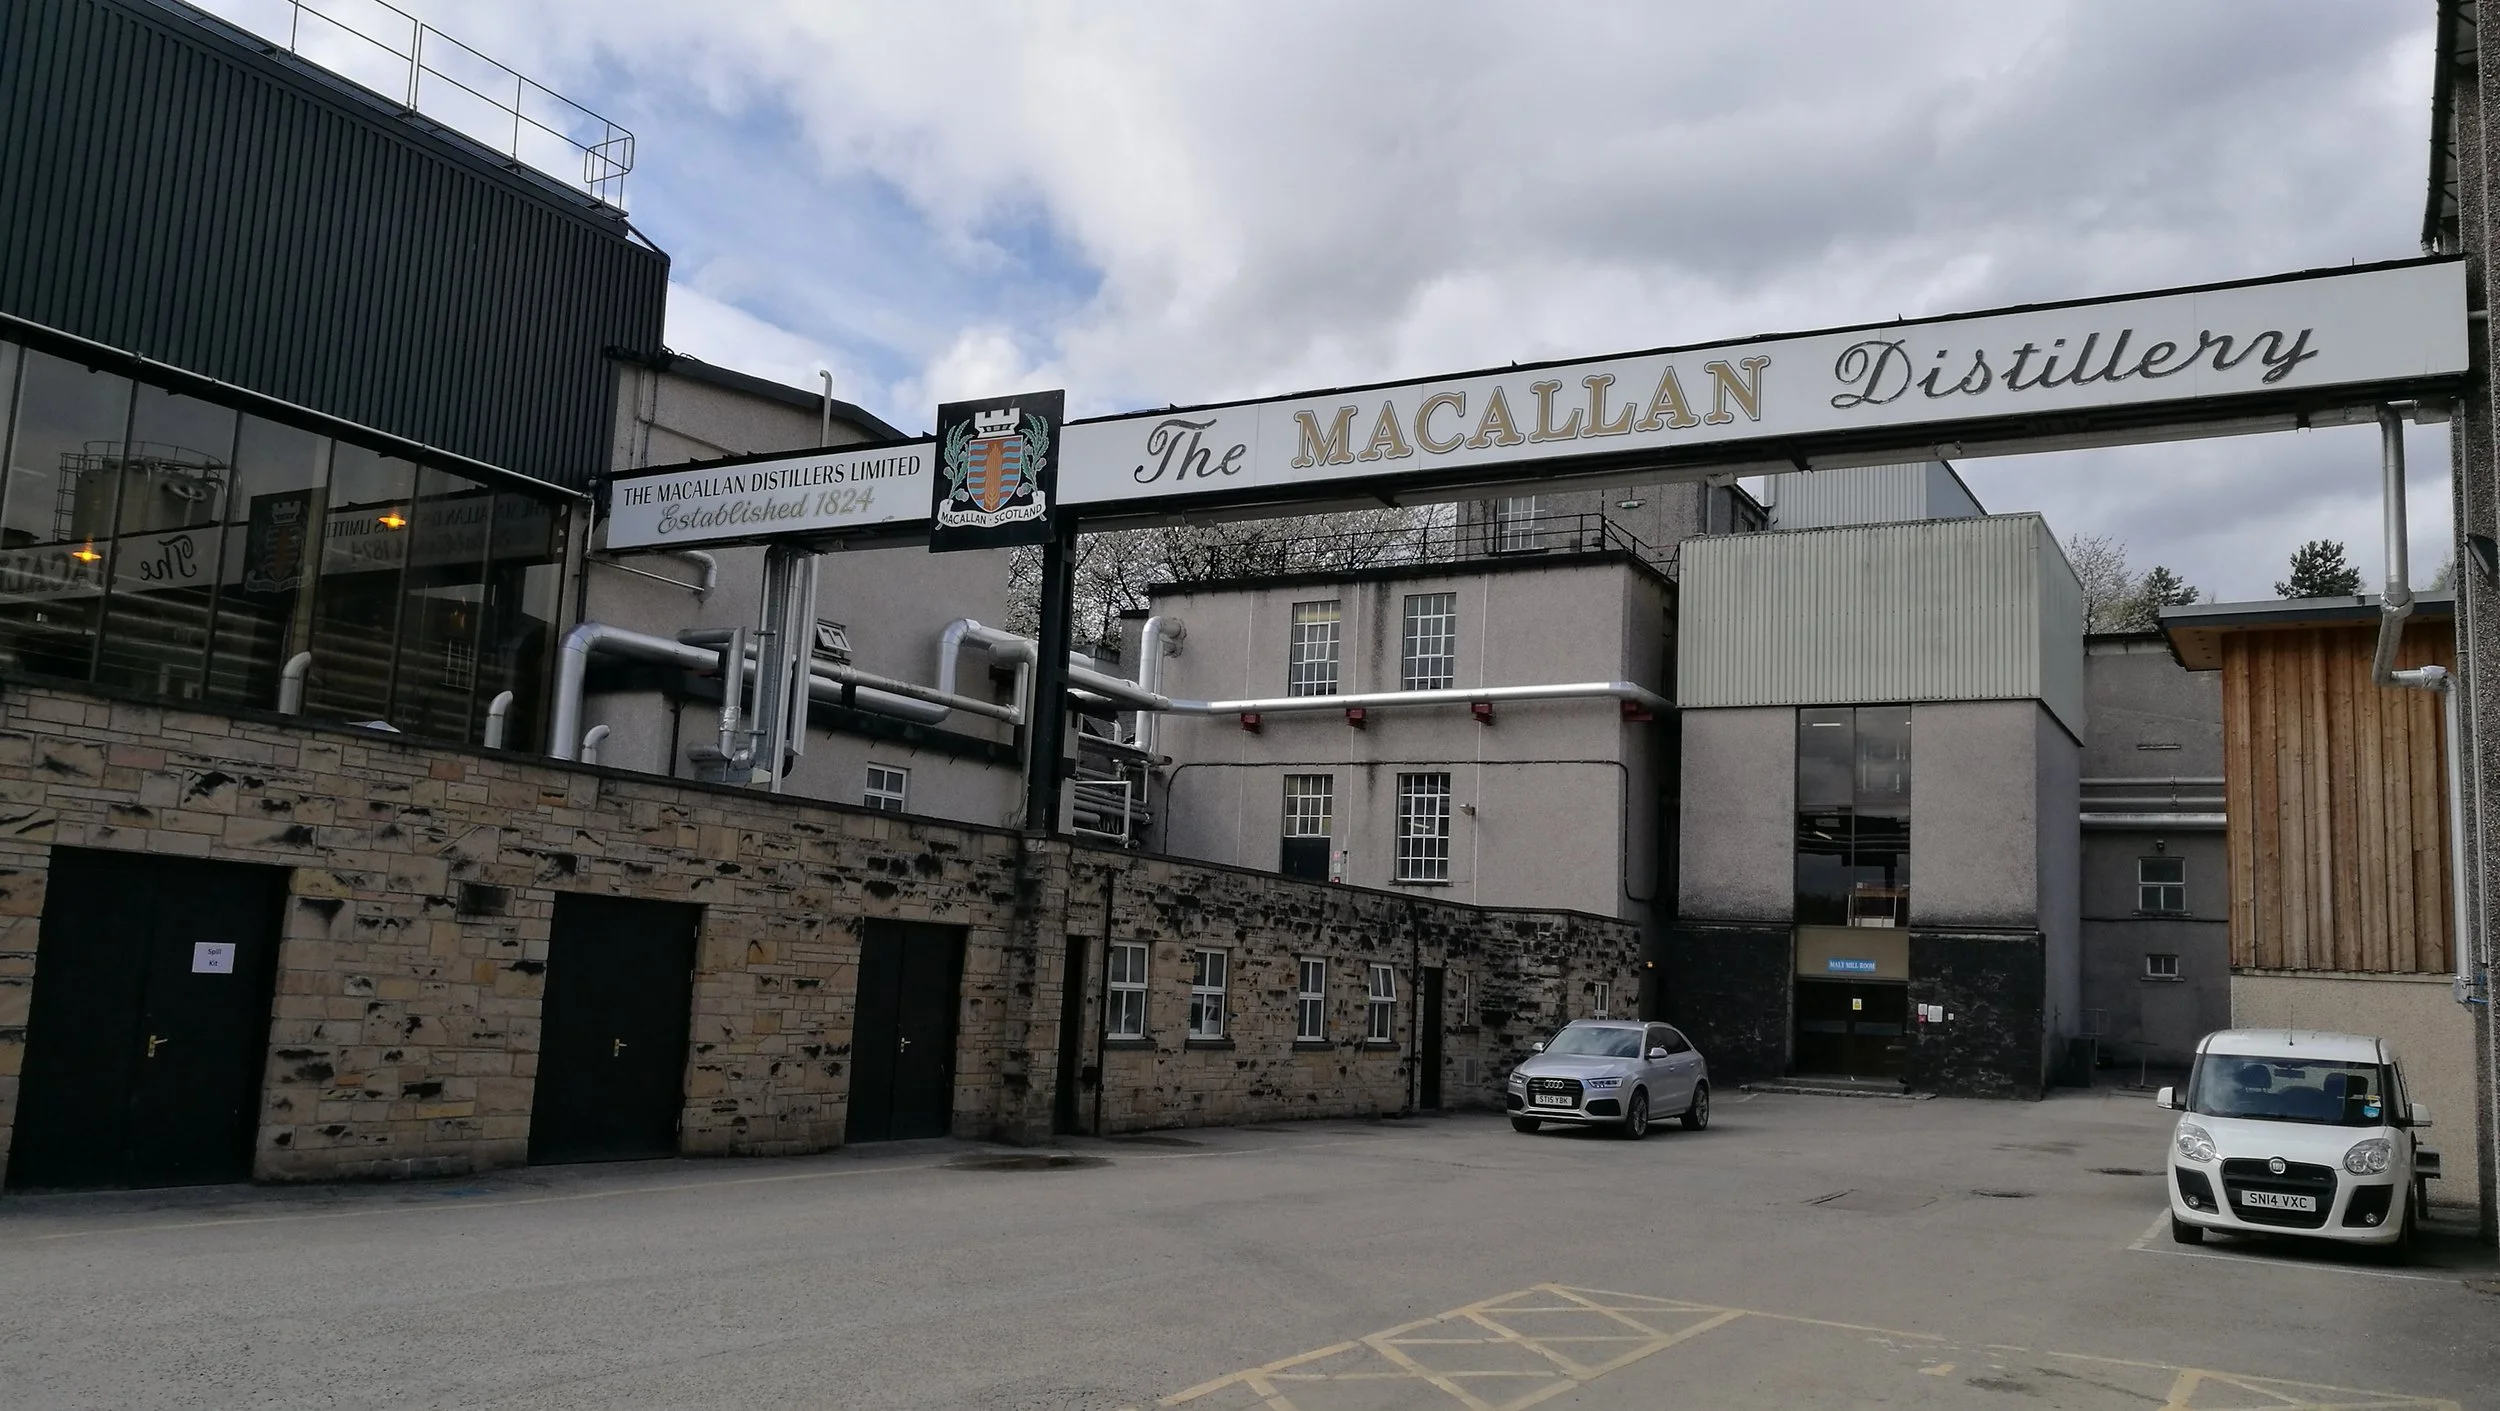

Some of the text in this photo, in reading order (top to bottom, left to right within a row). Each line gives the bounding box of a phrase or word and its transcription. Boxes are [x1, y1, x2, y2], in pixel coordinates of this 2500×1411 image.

[1132, 327, 2320, 485] The MACALLAN Distillery
[624, 455, 921, 507] THE MACALLAN DISTILLERS LIMITED
[658, 484, 876, 535] Established 1824
[941, 503, 1042, 525] MACALLAN SCOTLAND
[2249, 1192, 2308, 1209] SN14 VXC
